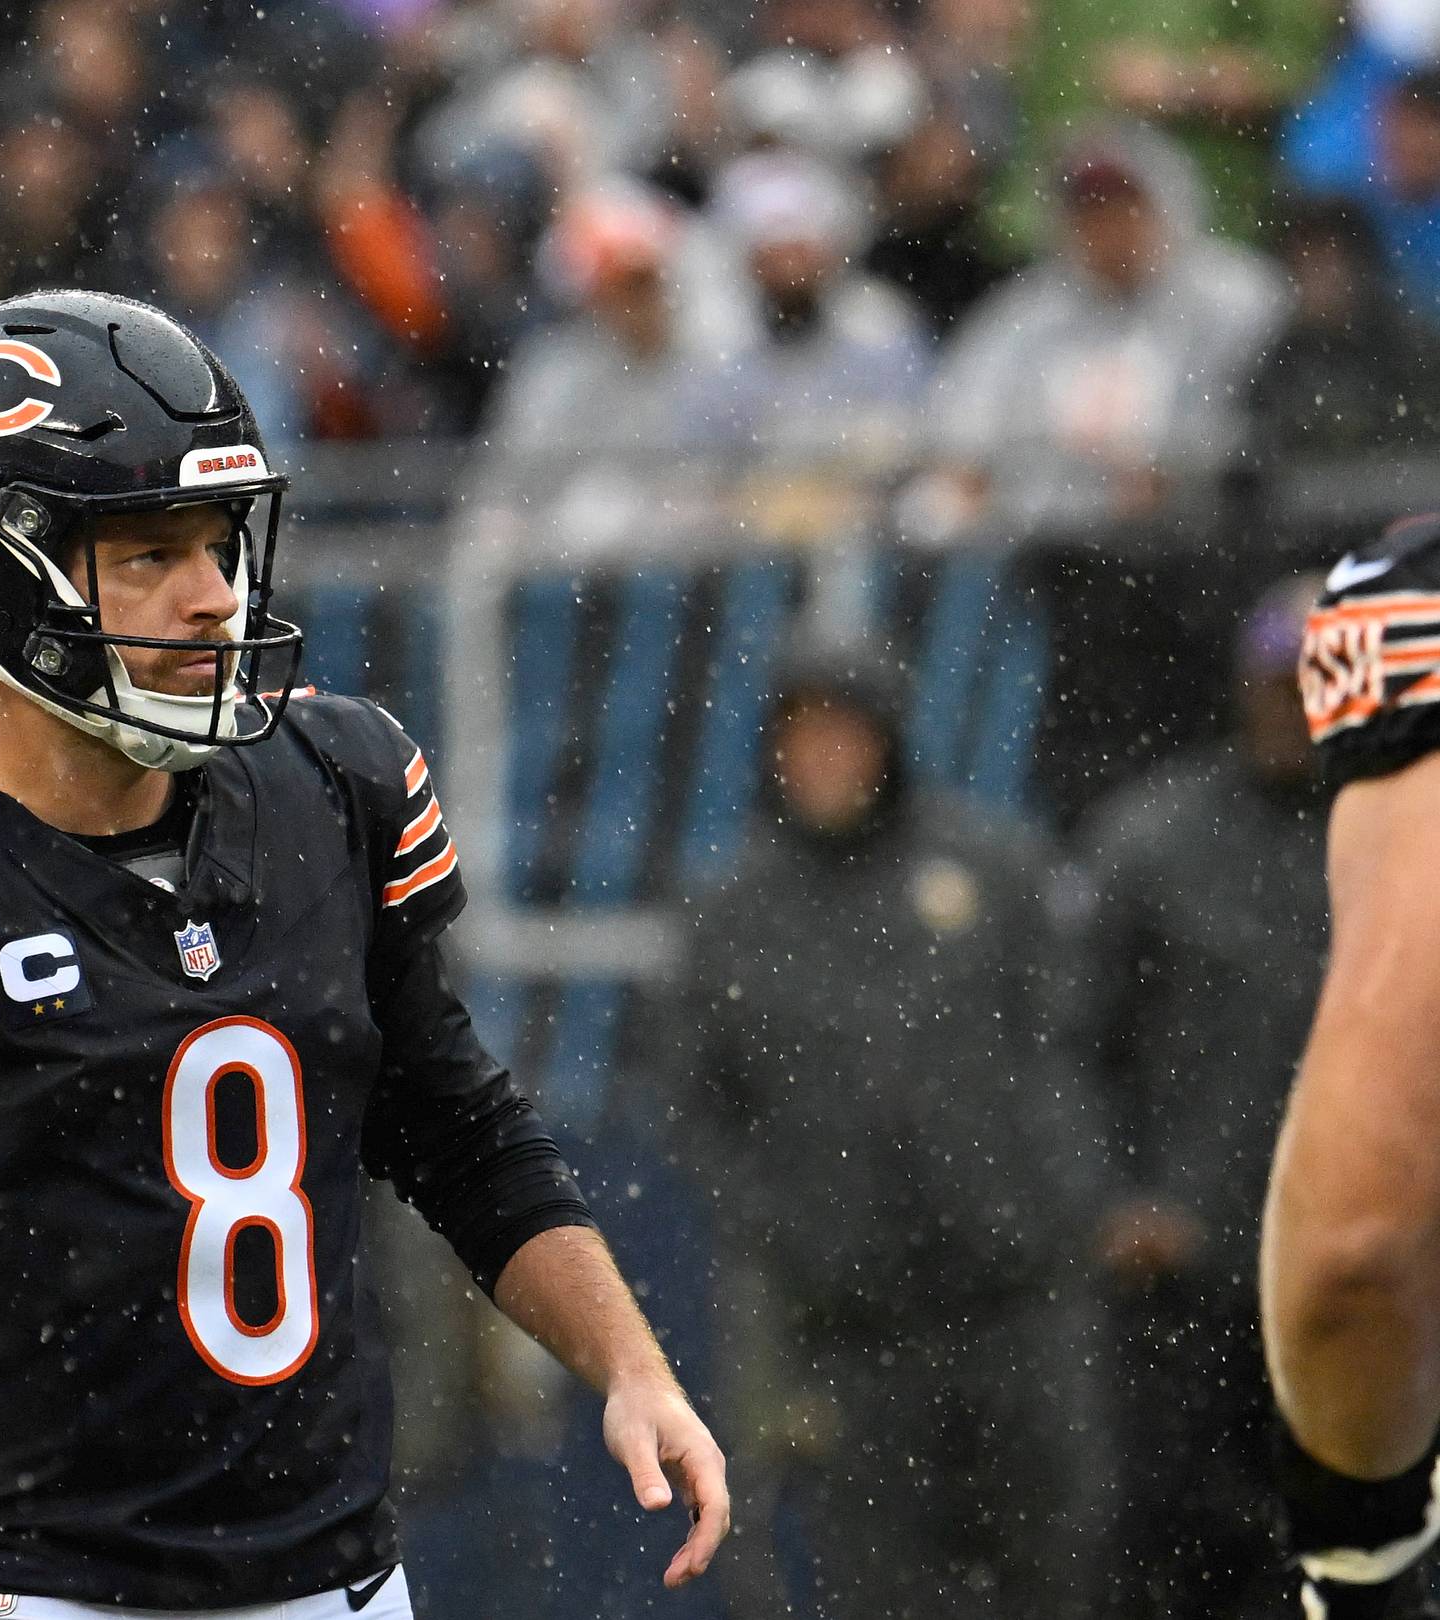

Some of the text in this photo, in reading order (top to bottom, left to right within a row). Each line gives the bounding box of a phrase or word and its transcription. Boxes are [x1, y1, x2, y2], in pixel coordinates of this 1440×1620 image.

[197, 453, 257, 474] BEARS
[186, 946, 216, 971] NFL
[161, 1015, 320, 1386] 8
